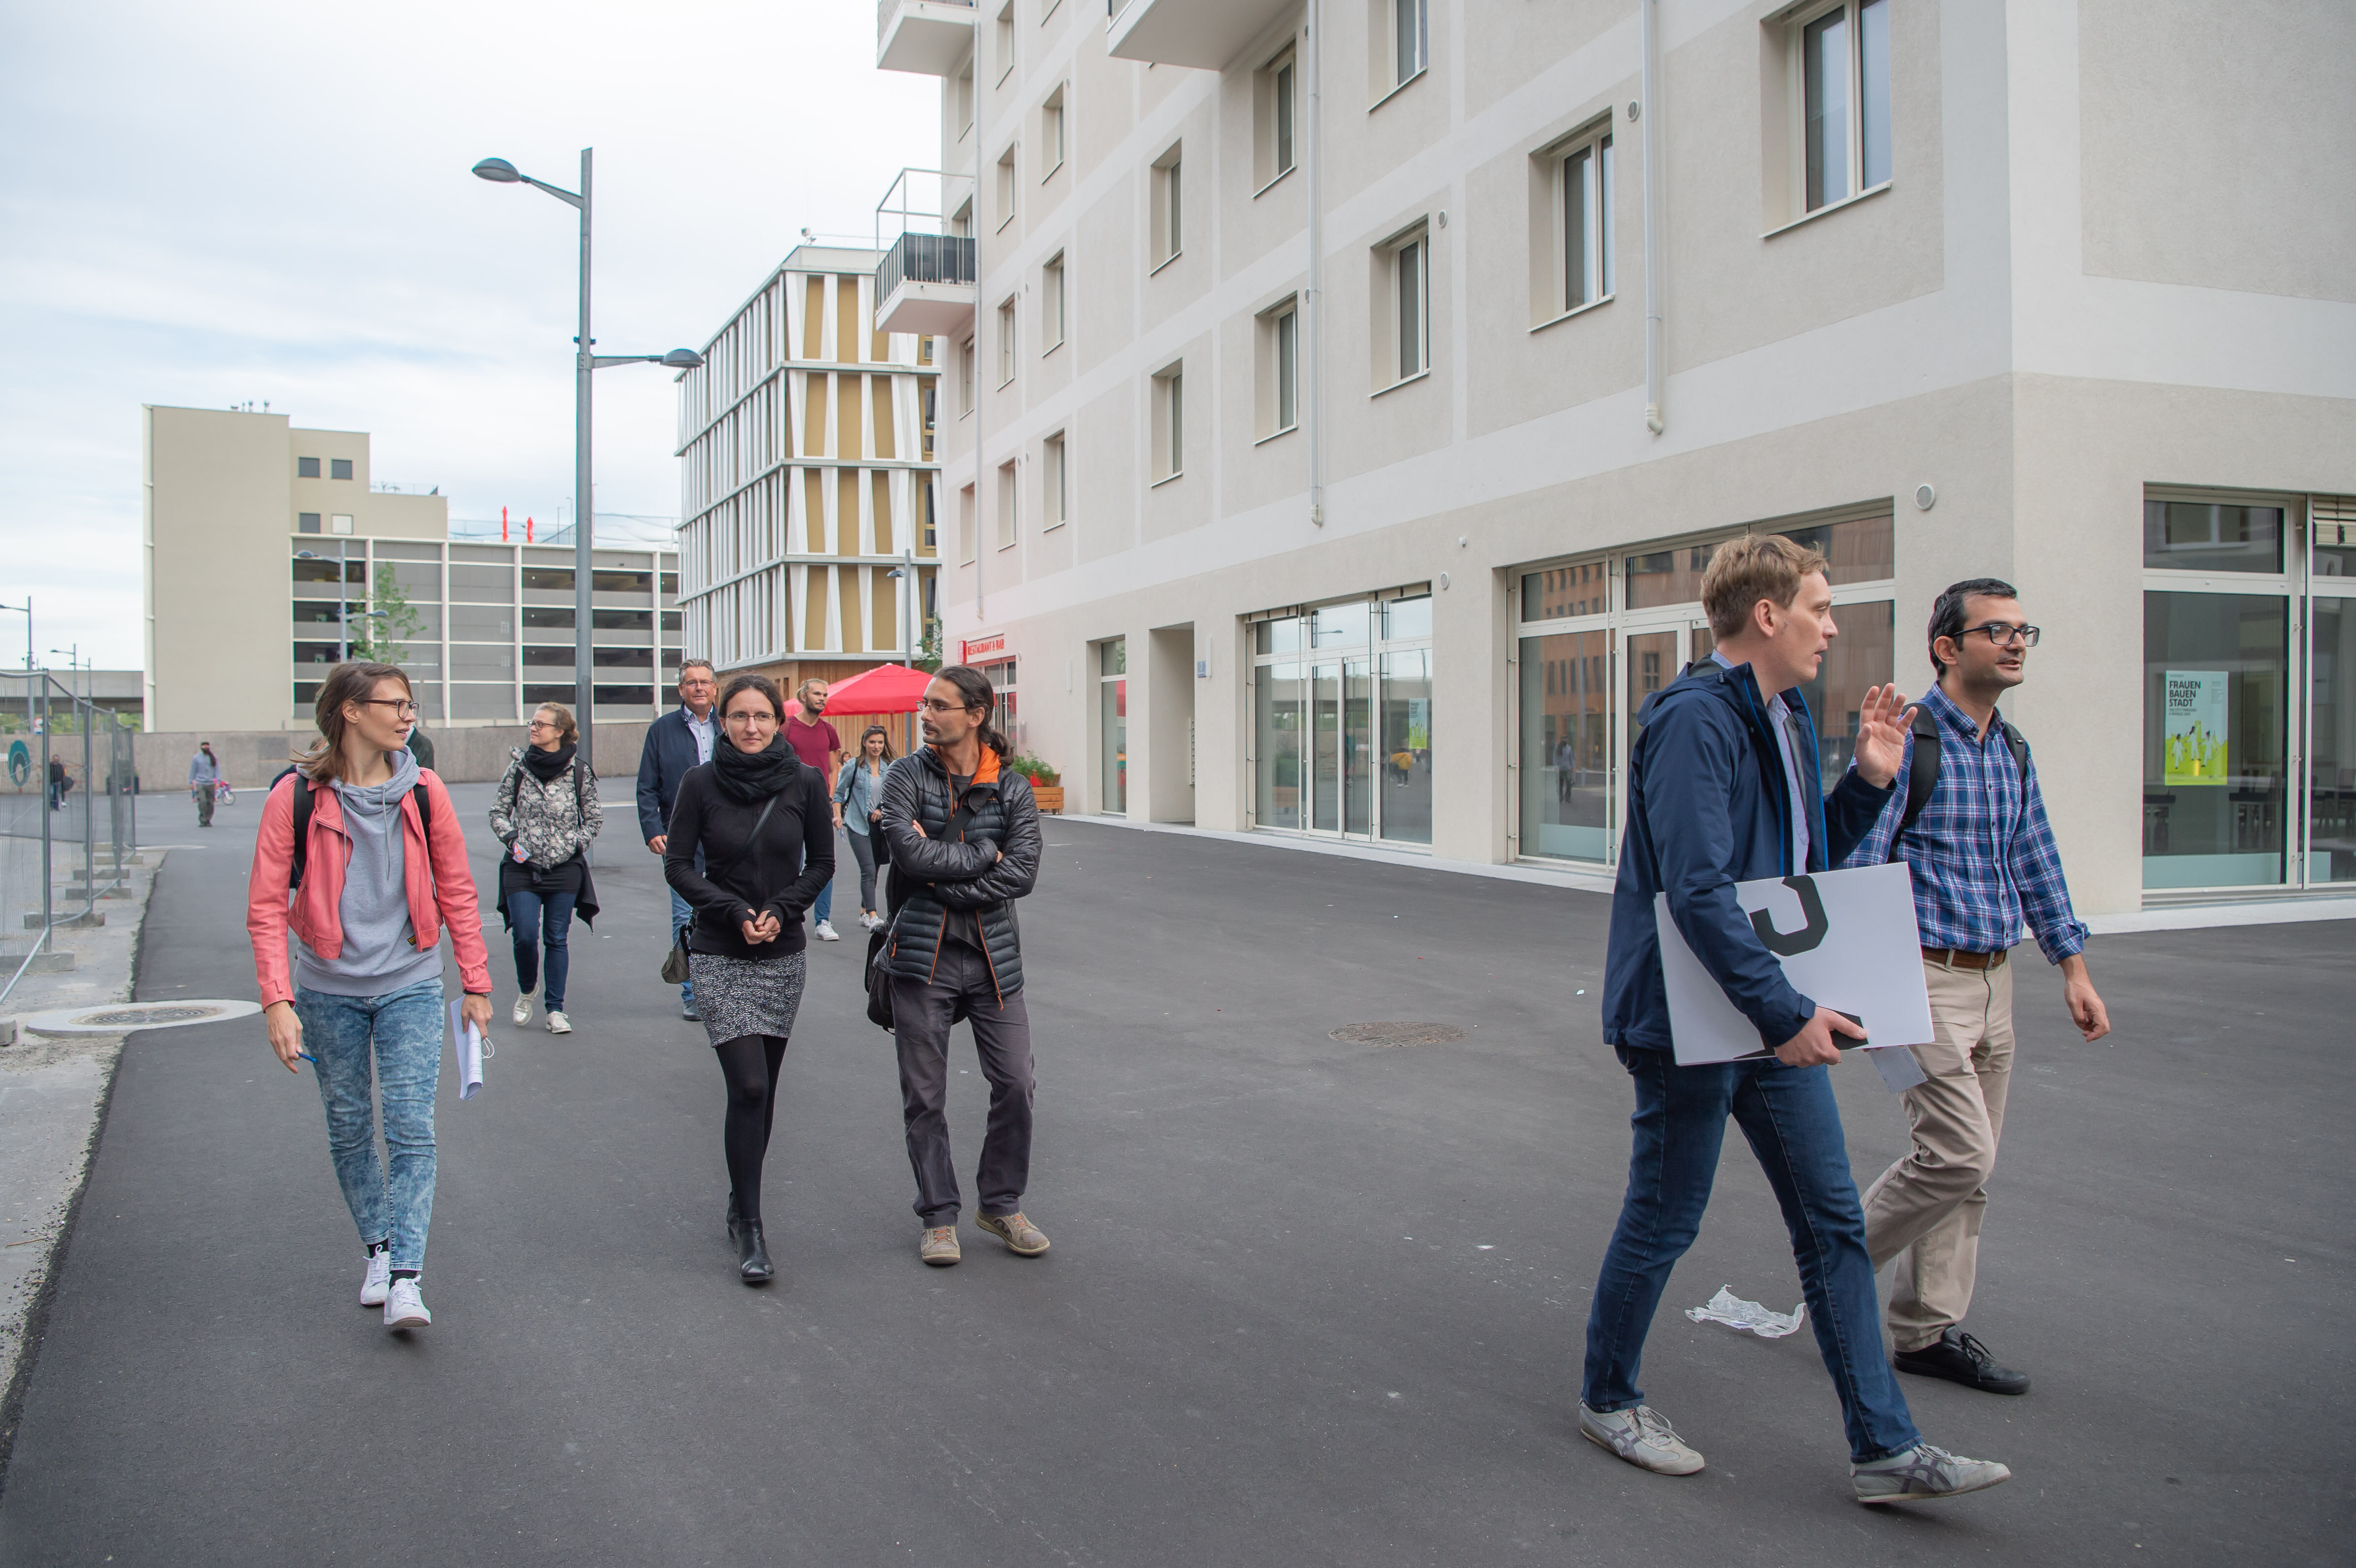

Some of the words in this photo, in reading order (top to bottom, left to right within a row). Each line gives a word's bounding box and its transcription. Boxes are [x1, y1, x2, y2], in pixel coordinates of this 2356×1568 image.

[968, 641, 992, 655] RESTAURANT
[996, 639, 1004, 650] BAR
[2169, 681, 2201, 689] FRAUEN
[2169, 699, 2194, 707] STADT
